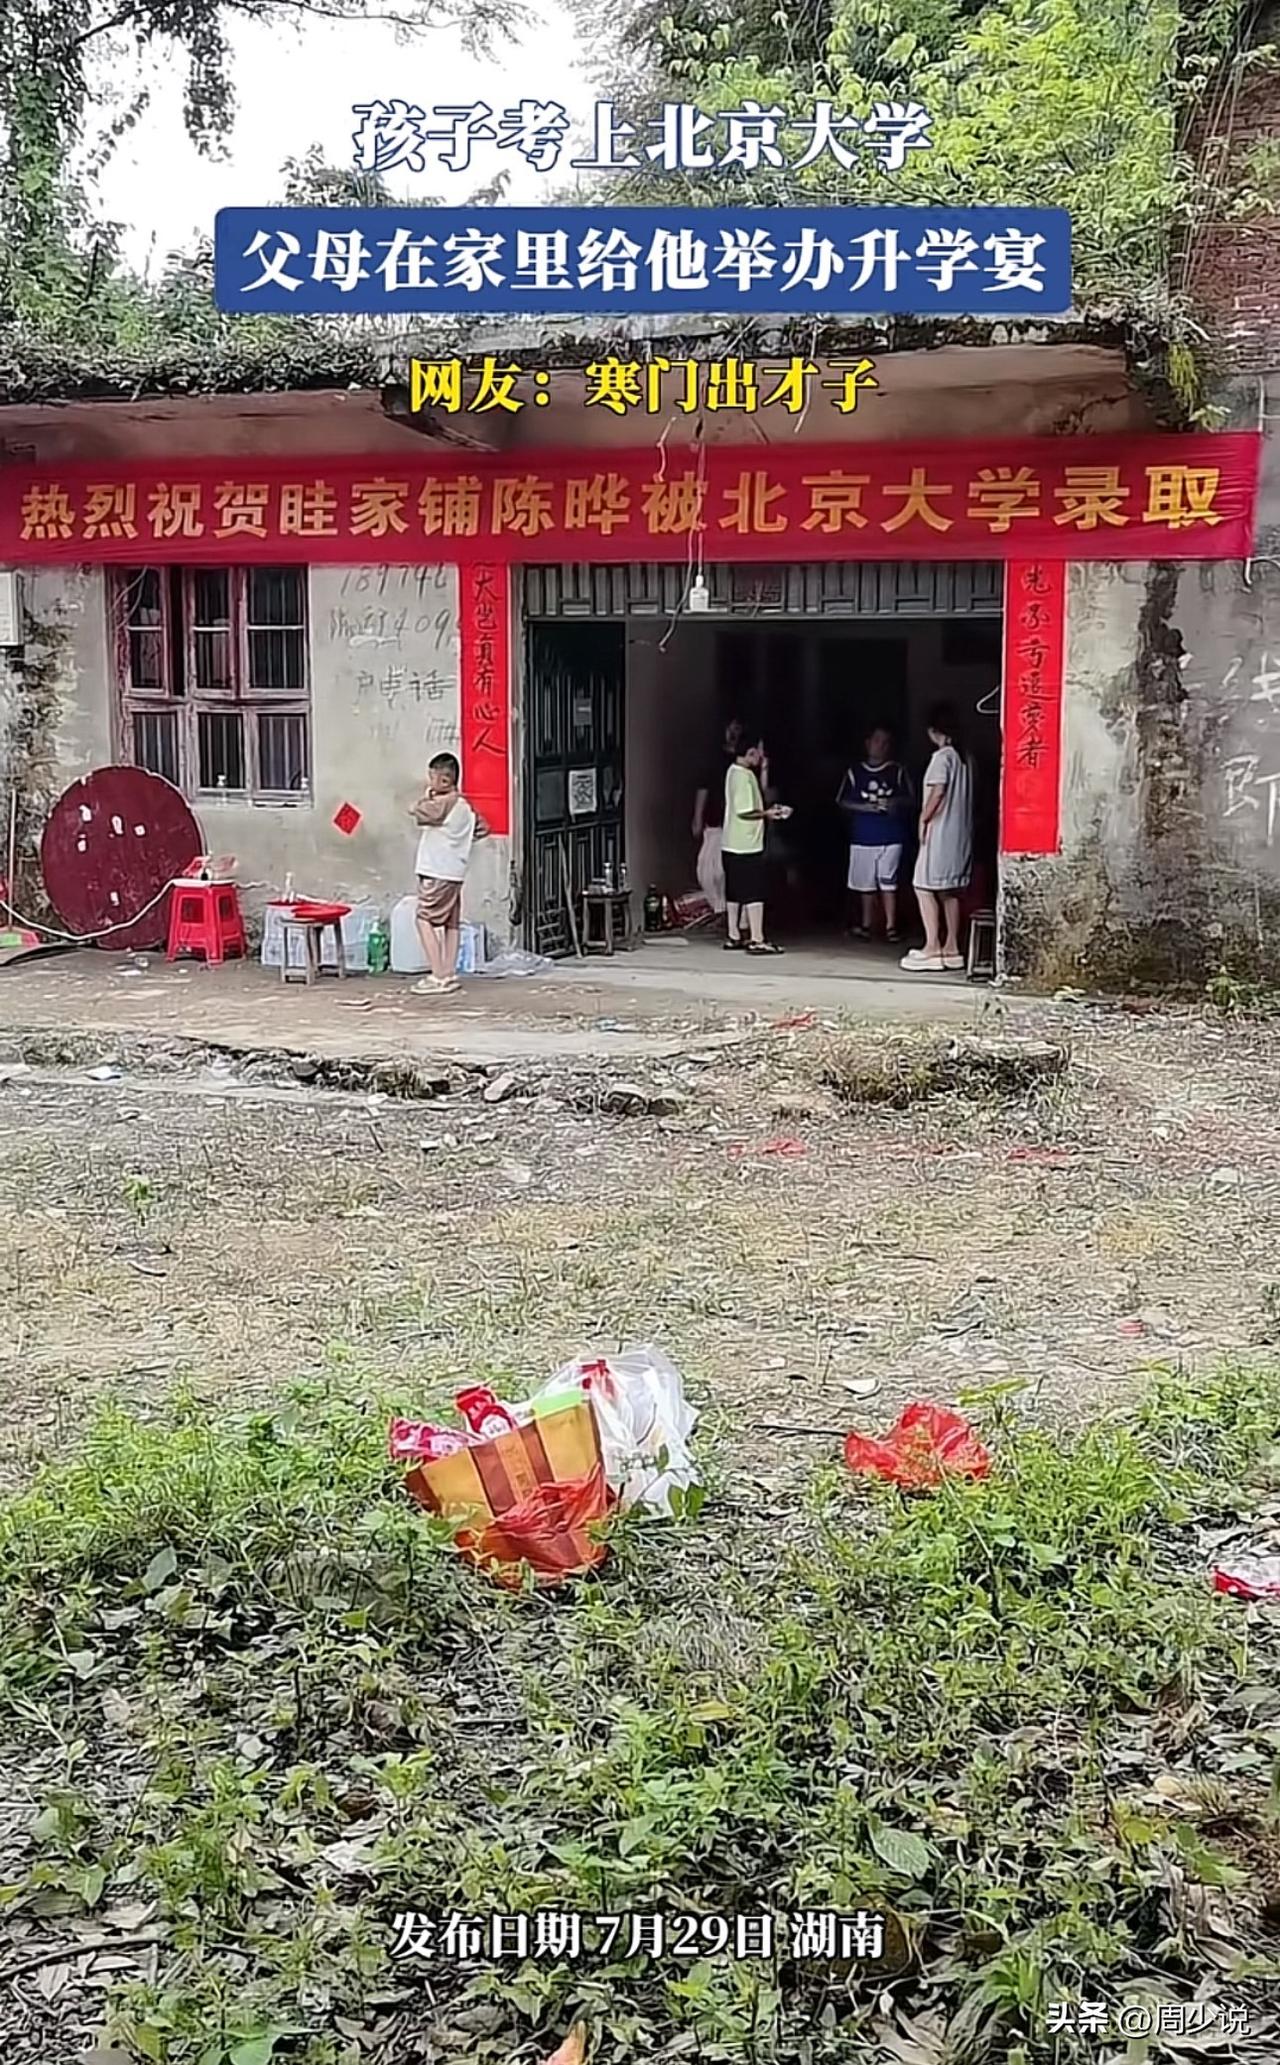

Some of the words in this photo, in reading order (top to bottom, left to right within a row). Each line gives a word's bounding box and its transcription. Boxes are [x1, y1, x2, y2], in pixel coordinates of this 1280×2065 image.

[19, 464, 1225, 541] 热烈祝贺眭家铺陈晔被北京大学录取
